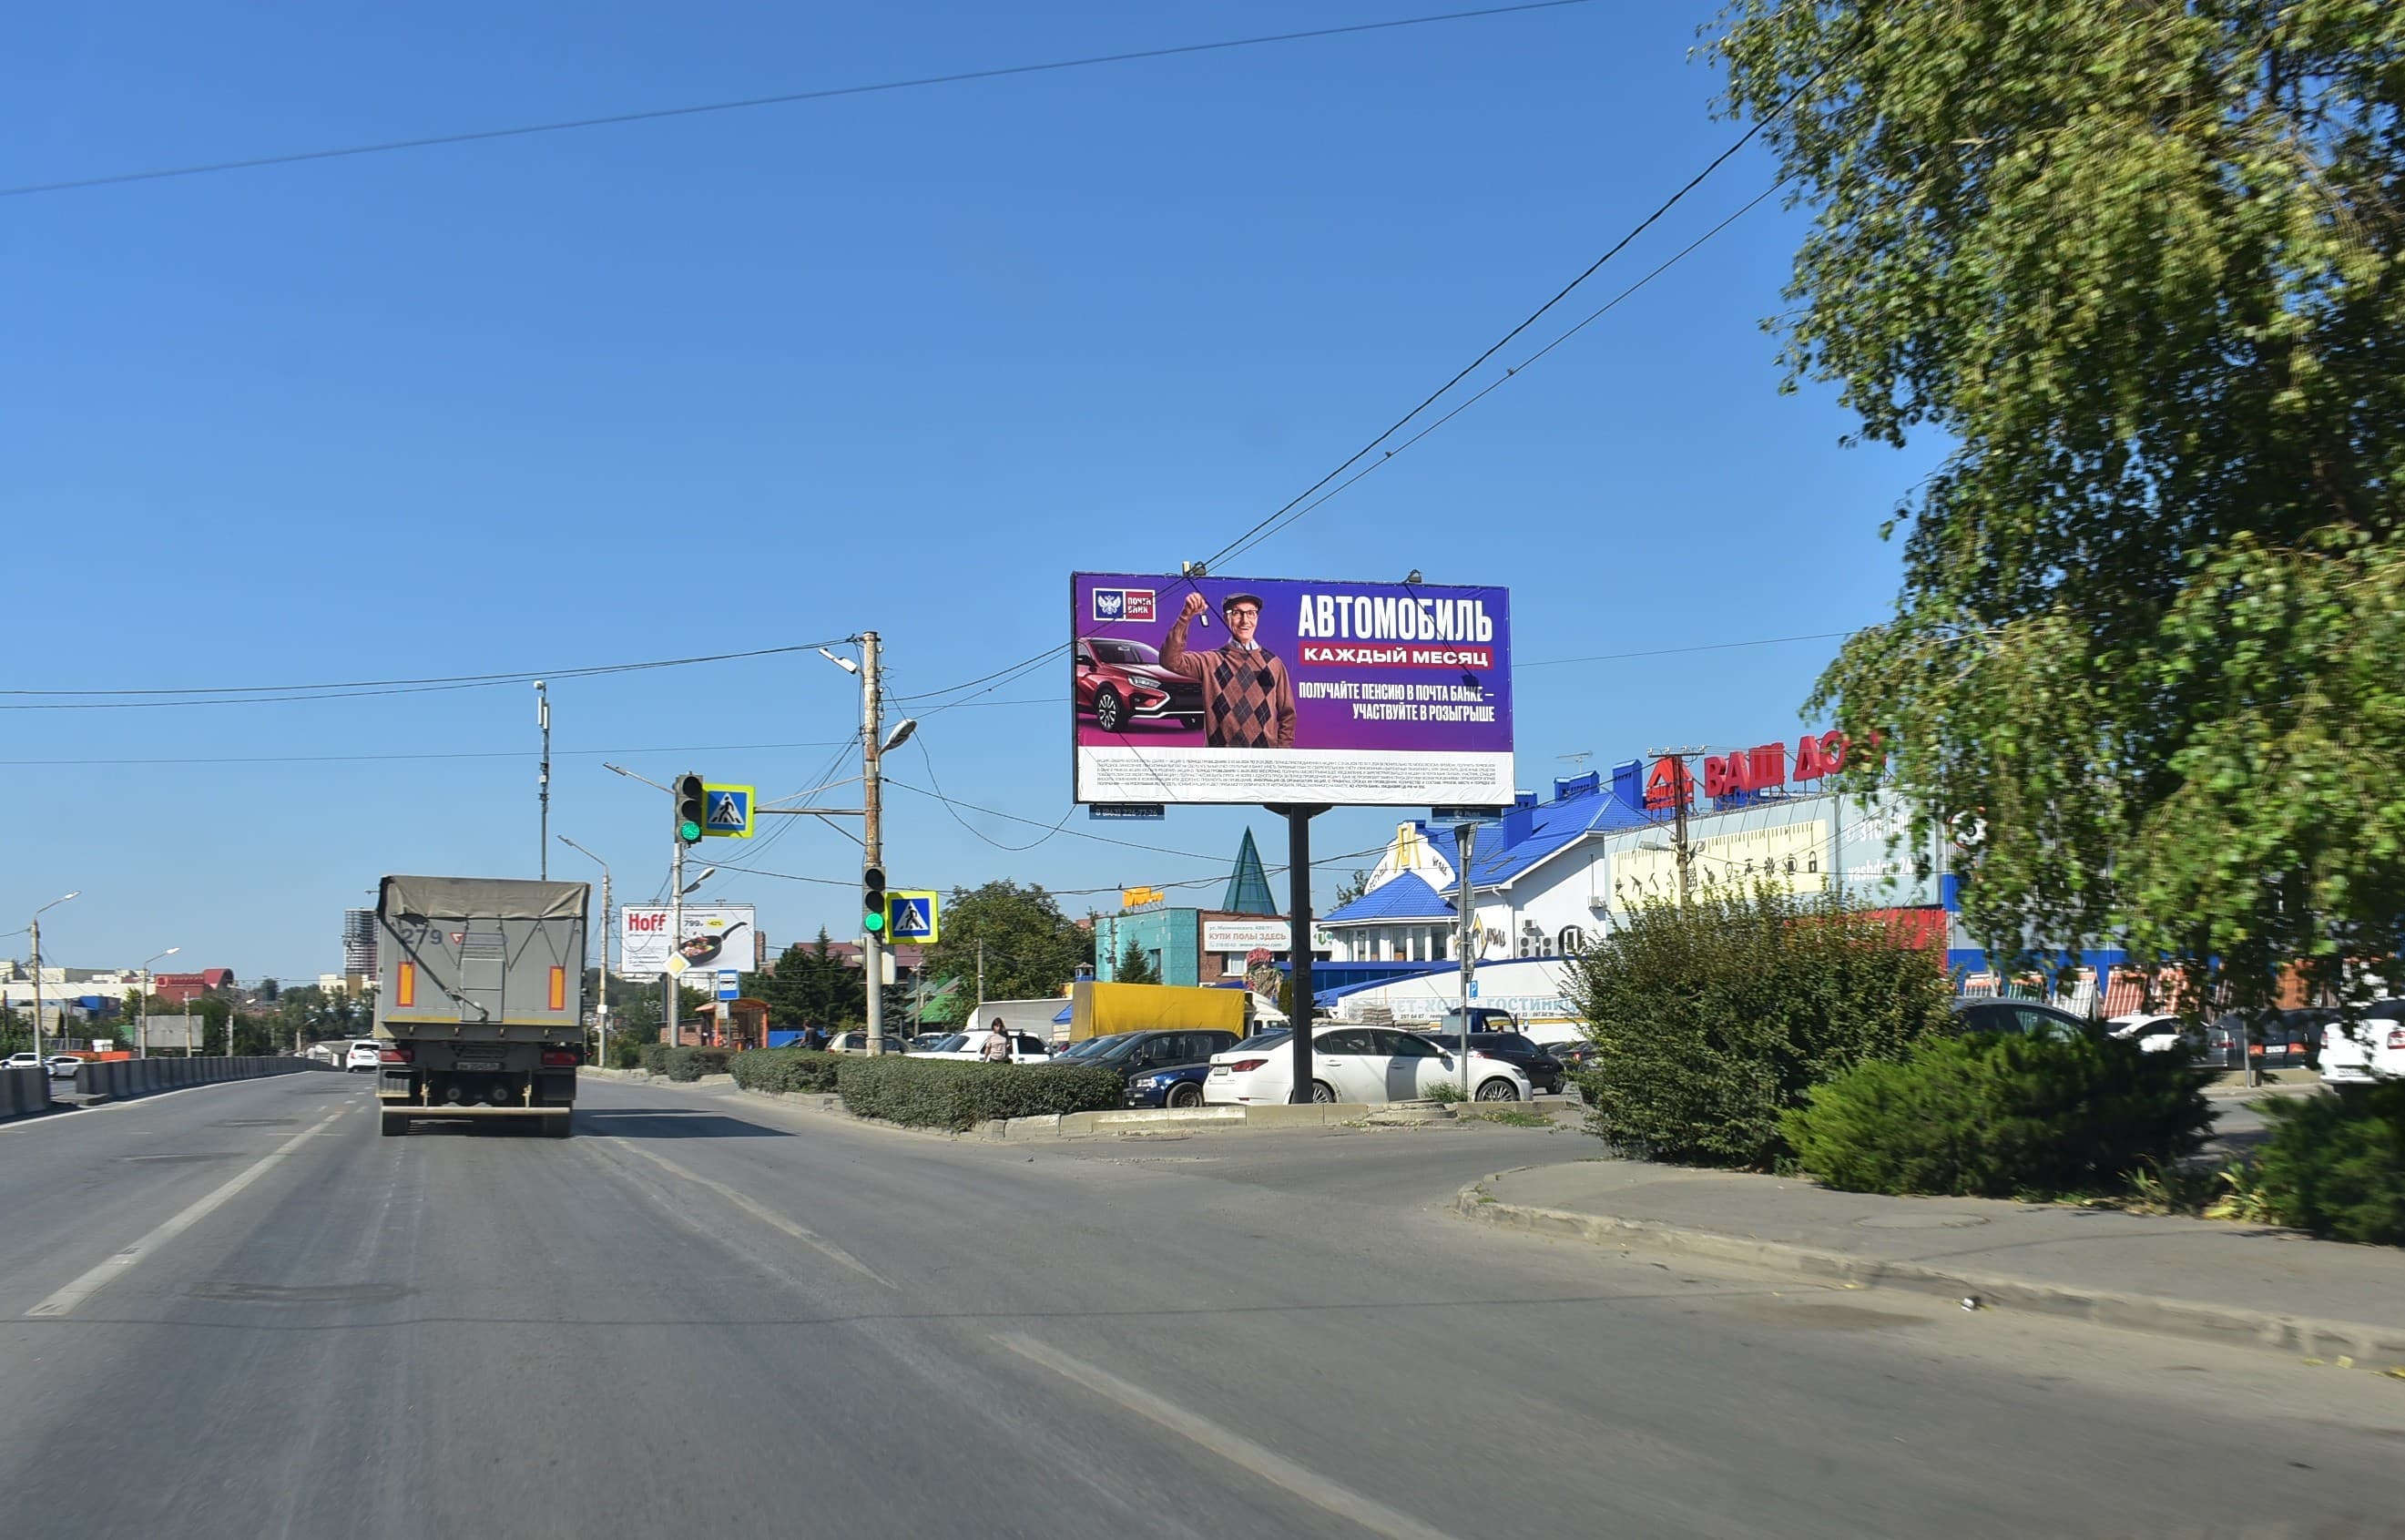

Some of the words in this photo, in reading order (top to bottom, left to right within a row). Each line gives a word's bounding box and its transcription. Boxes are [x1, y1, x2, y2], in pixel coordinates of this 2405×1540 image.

[1127, 597, 1152, 606] ПОЧТА
[1127, 606, 1149, 614] БАНК
[1298, 594, 1493, 642] АВТОМОБИЛЬ
[1303, 647, 1408, 664] КАЖДЫЙ
[1412, 649, 1489, 667] МЕСЯЦ
[1299, 680, 1360, 699] ПОЛУЧАЙТЕ
[1361, 683, 1405, 701] ПЕНСИЮ
[1406, 684, 1414, 701] В
[1415, 685, 1449, 701] ПОЧТА
[1450, 686, 1483, 702] БАНКЕ
[1352, 702, 1418, 721] УЧАСТВУЙТЕ
[1420, 706, 1427, 721] В
[1429, 706, 1495, 722] РОЗЫГРЫШЕ
[1704, 741, 1785, 799] ВАШ
[1792, 729, 1888, 781] ДО
[628, 913, 667, 932] Hoff
[401, 929, 443, 945] 279
[1208, 933, 1231, 941] КУПИ
[1233, 933, 1258, 941] ПОЛЫ
[1259, 933, 1287, 941] ЗДЕСЬ
